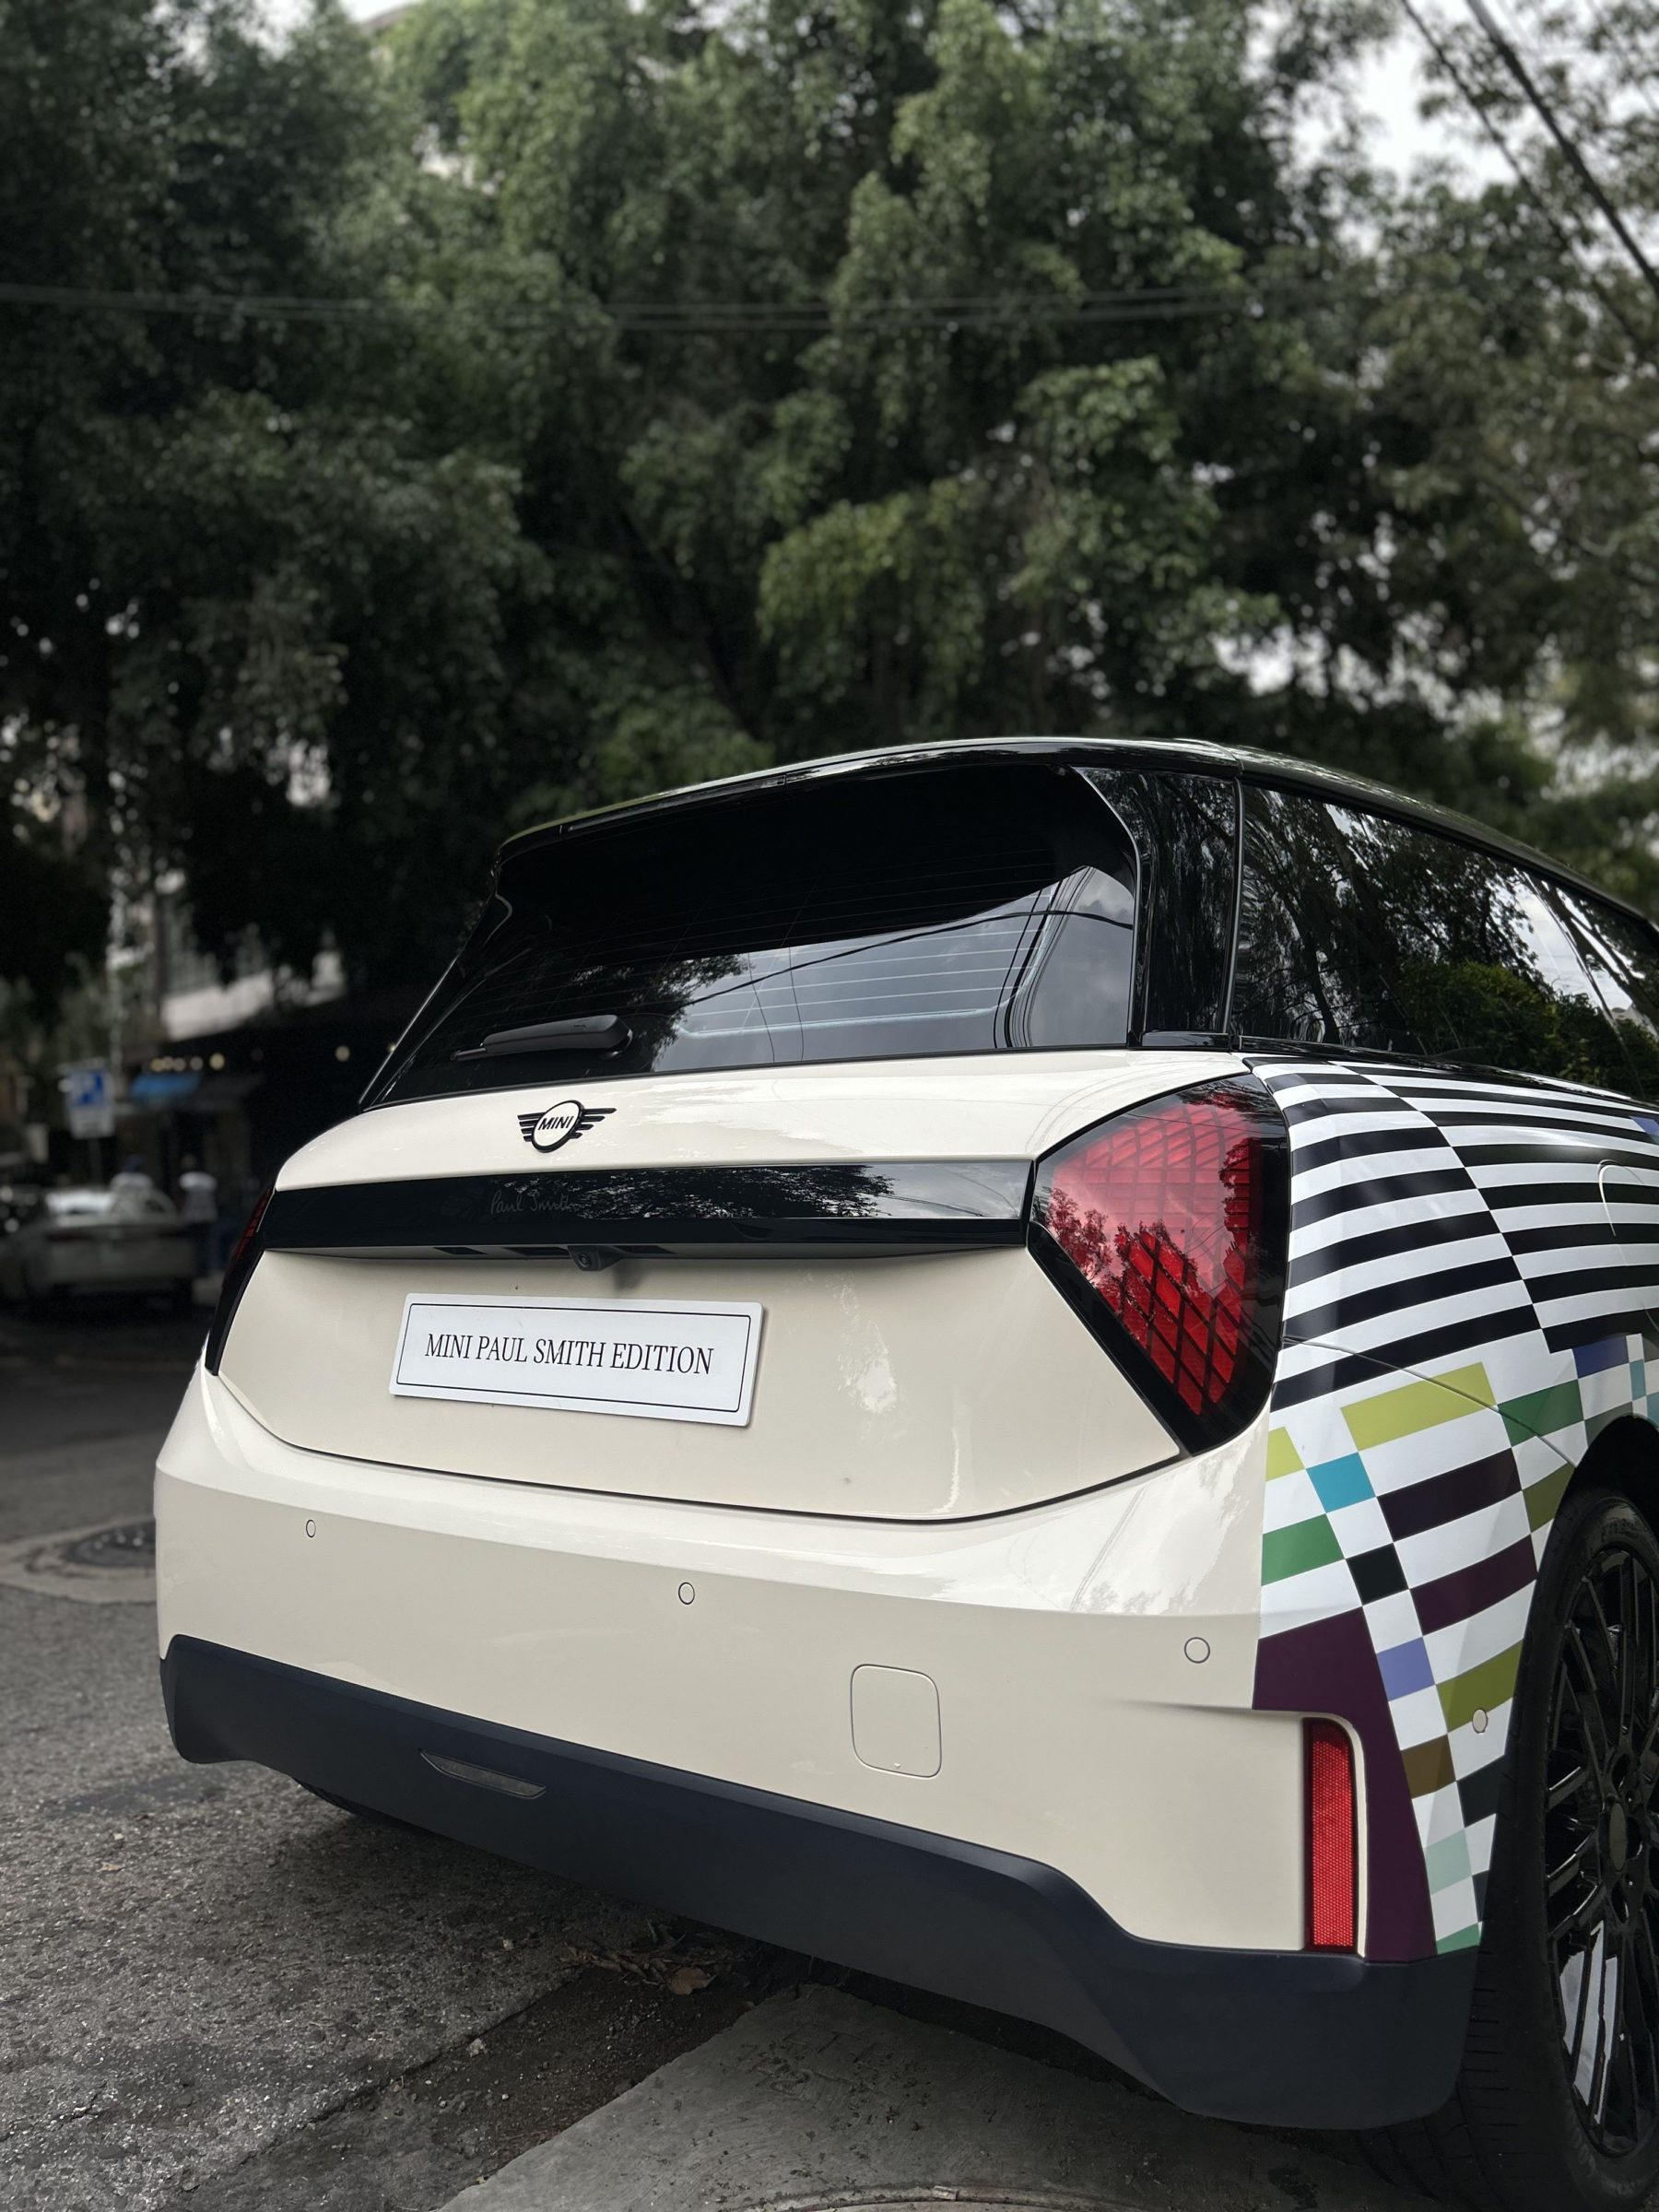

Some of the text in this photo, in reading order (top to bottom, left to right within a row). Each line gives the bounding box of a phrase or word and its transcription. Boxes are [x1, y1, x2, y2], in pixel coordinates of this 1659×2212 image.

[537, 1115, 574, 1131] MINI
[490, 1189, 524, 1216] Paul
[425, 1333, 715, 1374] MINI PAUL SMITH EDITION
